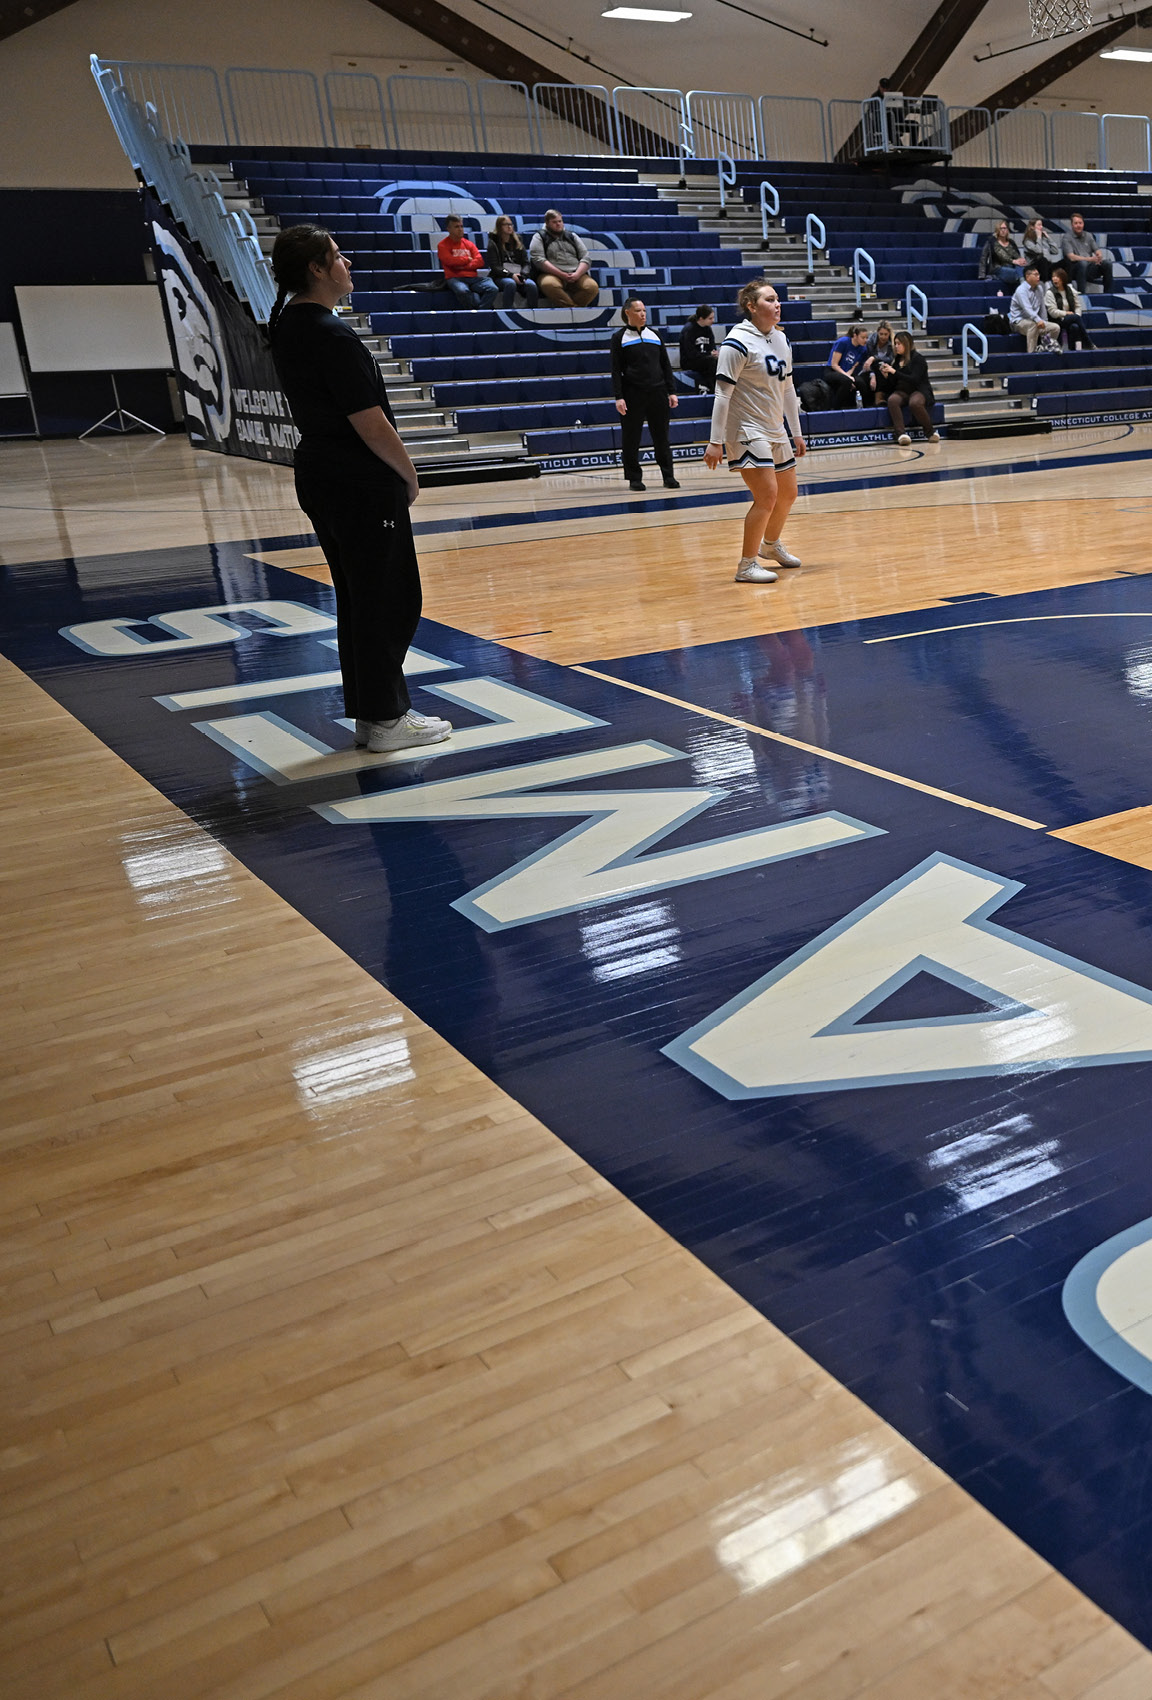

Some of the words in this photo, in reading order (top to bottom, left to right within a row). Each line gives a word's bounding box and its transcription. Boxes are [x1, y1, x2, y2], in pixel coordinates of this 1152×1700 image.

[765, 354, 787, 382] CC
[232, 388, 285, 417] WELCOME
[235, 418, 270, 445] CAMEL
[1043, 415, 1100, 426] NNECTICUT
[1103, 411, 1140, 422] COLLEGE
[642, 447, 704, 460] ATETICS
